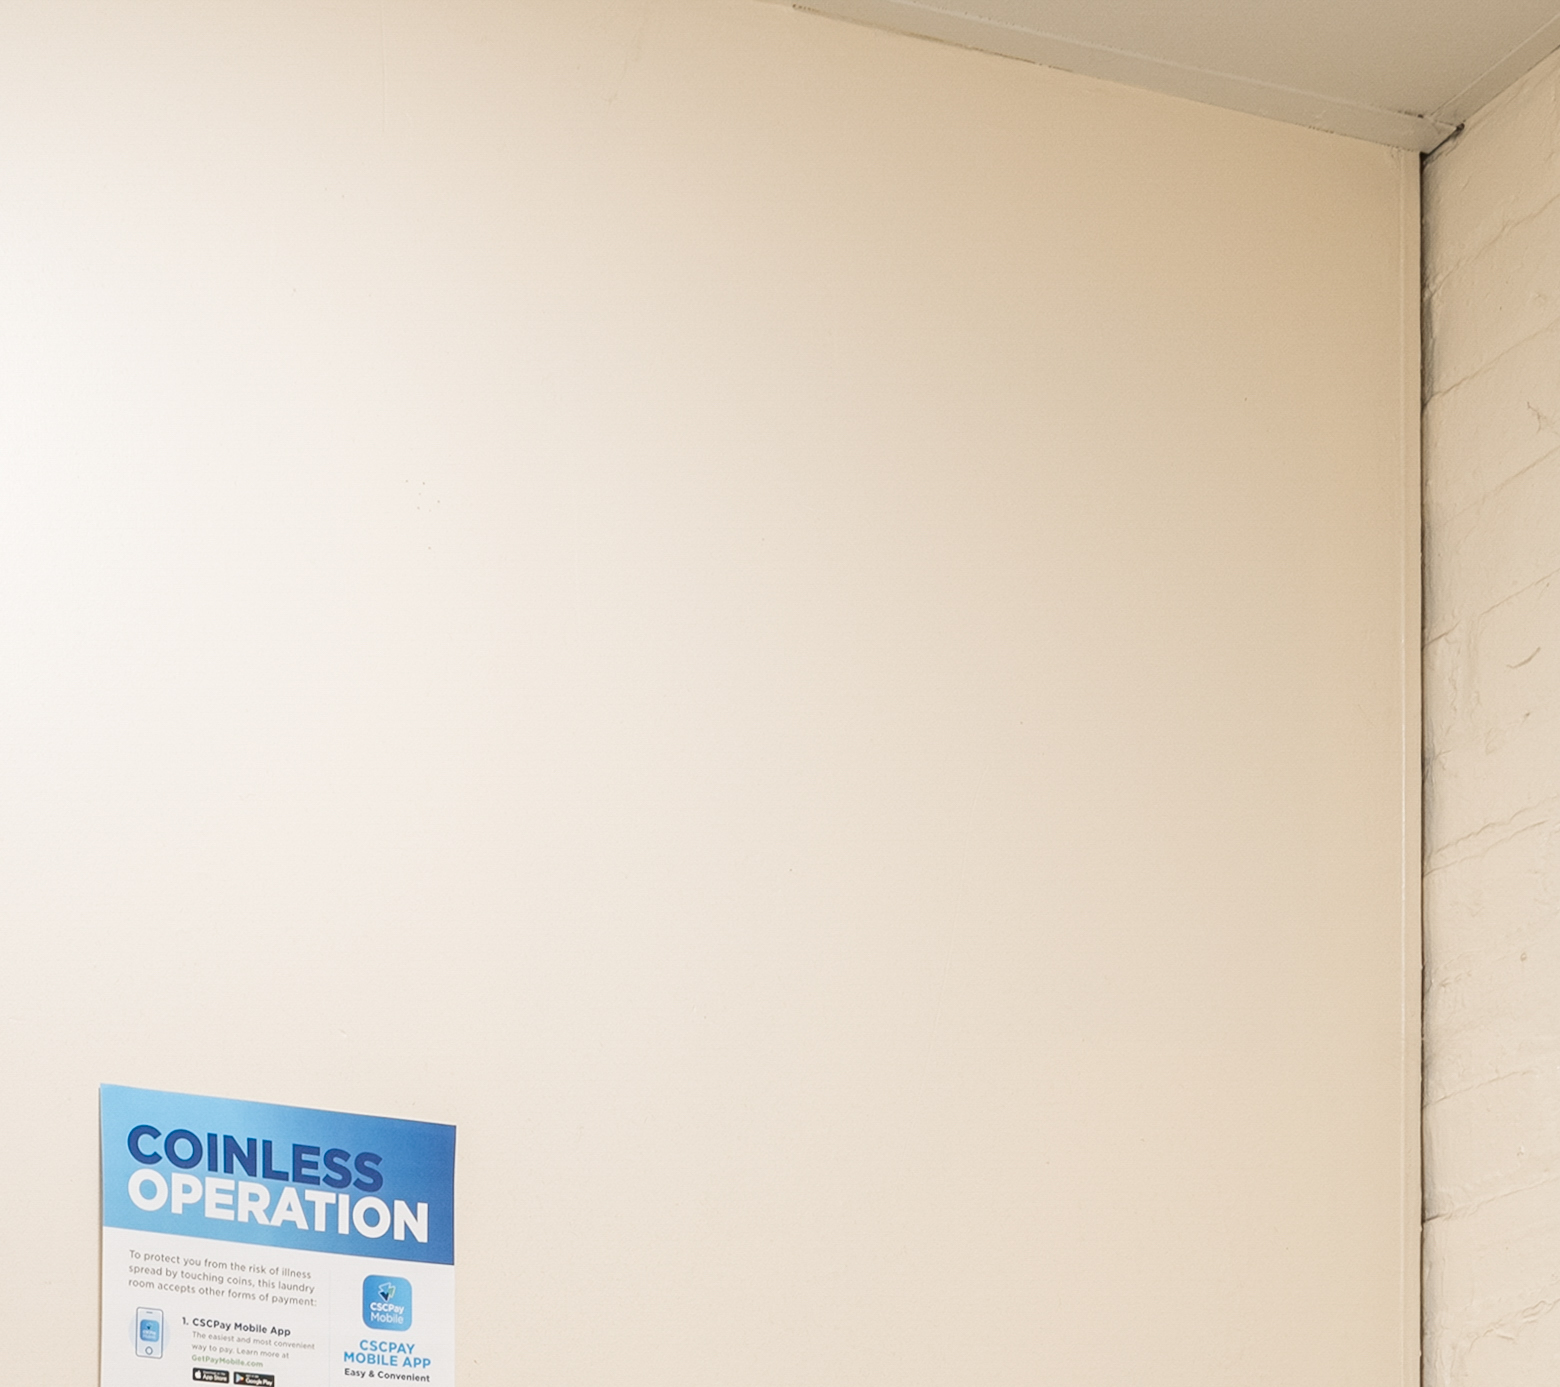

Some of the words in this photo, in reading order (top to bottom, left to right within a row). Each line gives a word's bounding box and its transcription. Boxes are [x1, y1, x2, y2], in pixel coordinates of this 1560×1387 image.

[127, 1124, 384, 1193] COINLESS
[127, 1168, 428, 1243] OPERATION
[182, 1316, 189, 1326] 1.
[192, 1317, 232, 1332] CSCPay
[233, 1322, 268, 1334] Mobile
[270, 1326, 291, 1338] App
[359, 1339, 416, 1355] CSCPAY
[343, 1351, 398, 1367] MOBILE
[402, 1356, 432, 1369] APP
[344, 1367, 366, 1379] Easy
[368, 1369, 375, 1378] &
[377, 1370, 430, 1383] Convenient
